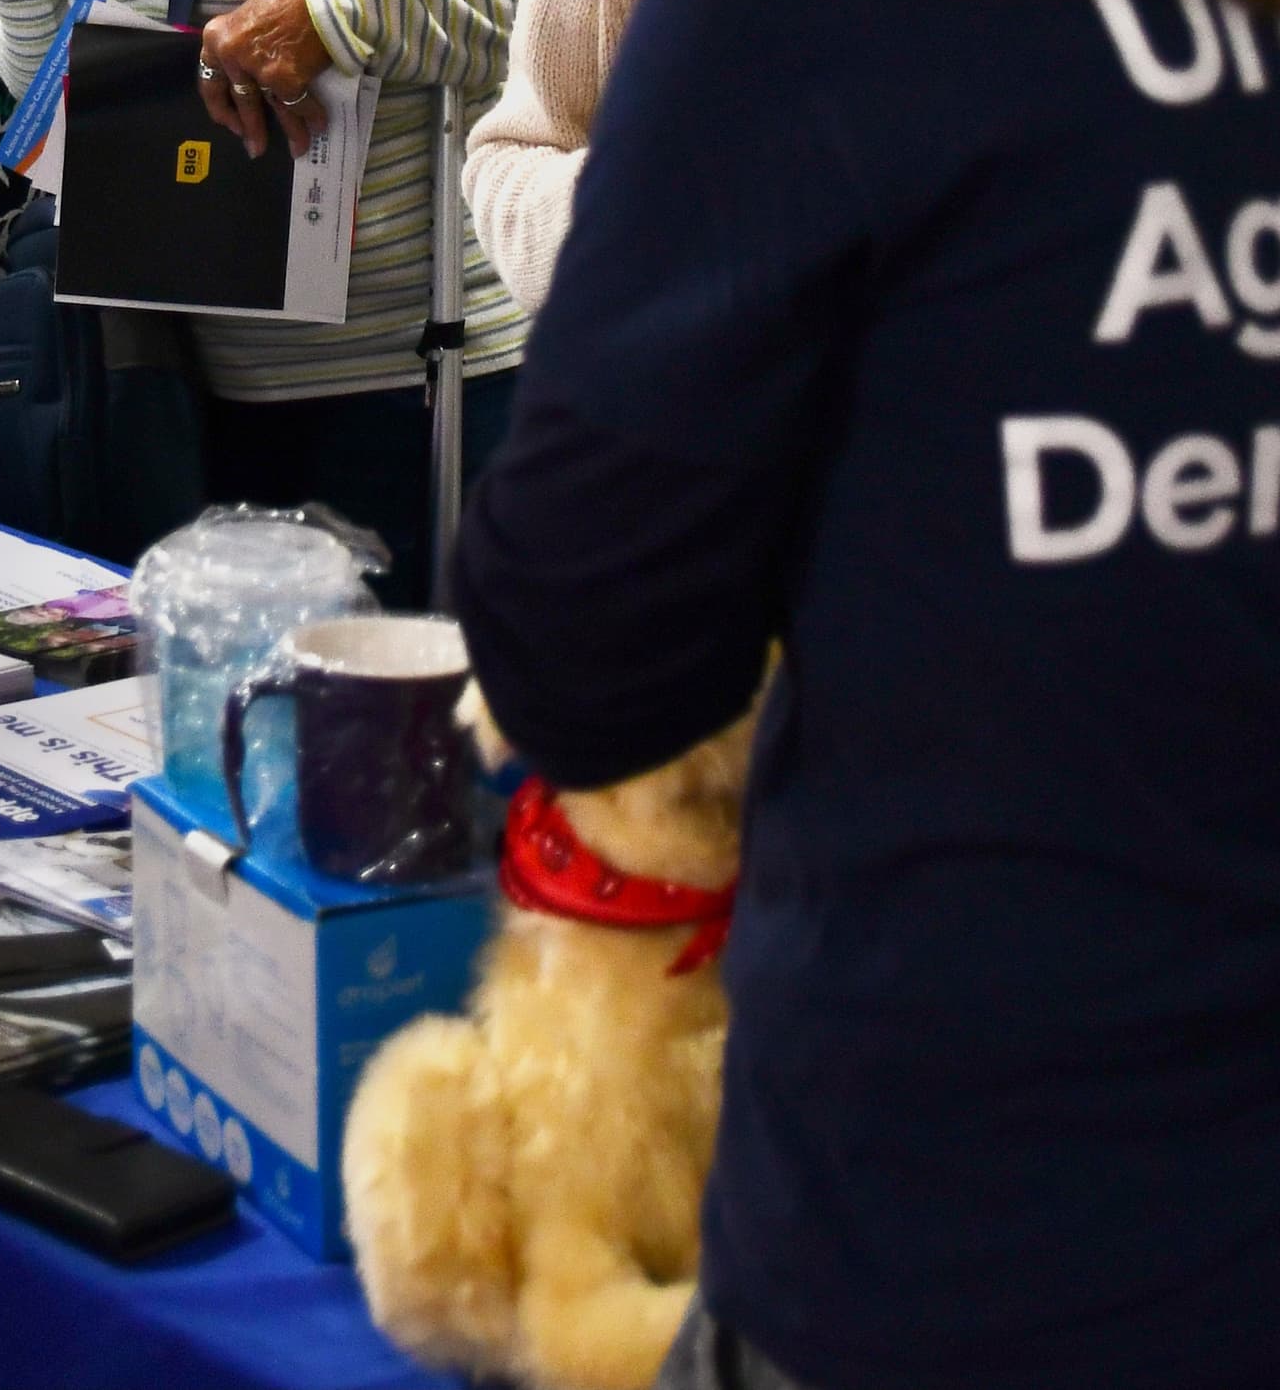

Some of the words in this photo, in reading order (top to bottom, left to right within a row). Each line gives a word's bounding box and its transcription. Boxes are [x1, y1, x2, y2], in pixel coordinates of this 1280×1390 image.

[183, 148, 197, 175] BIG
[39, 737, 74, 755] is
[70, 749, 139, 784] This
